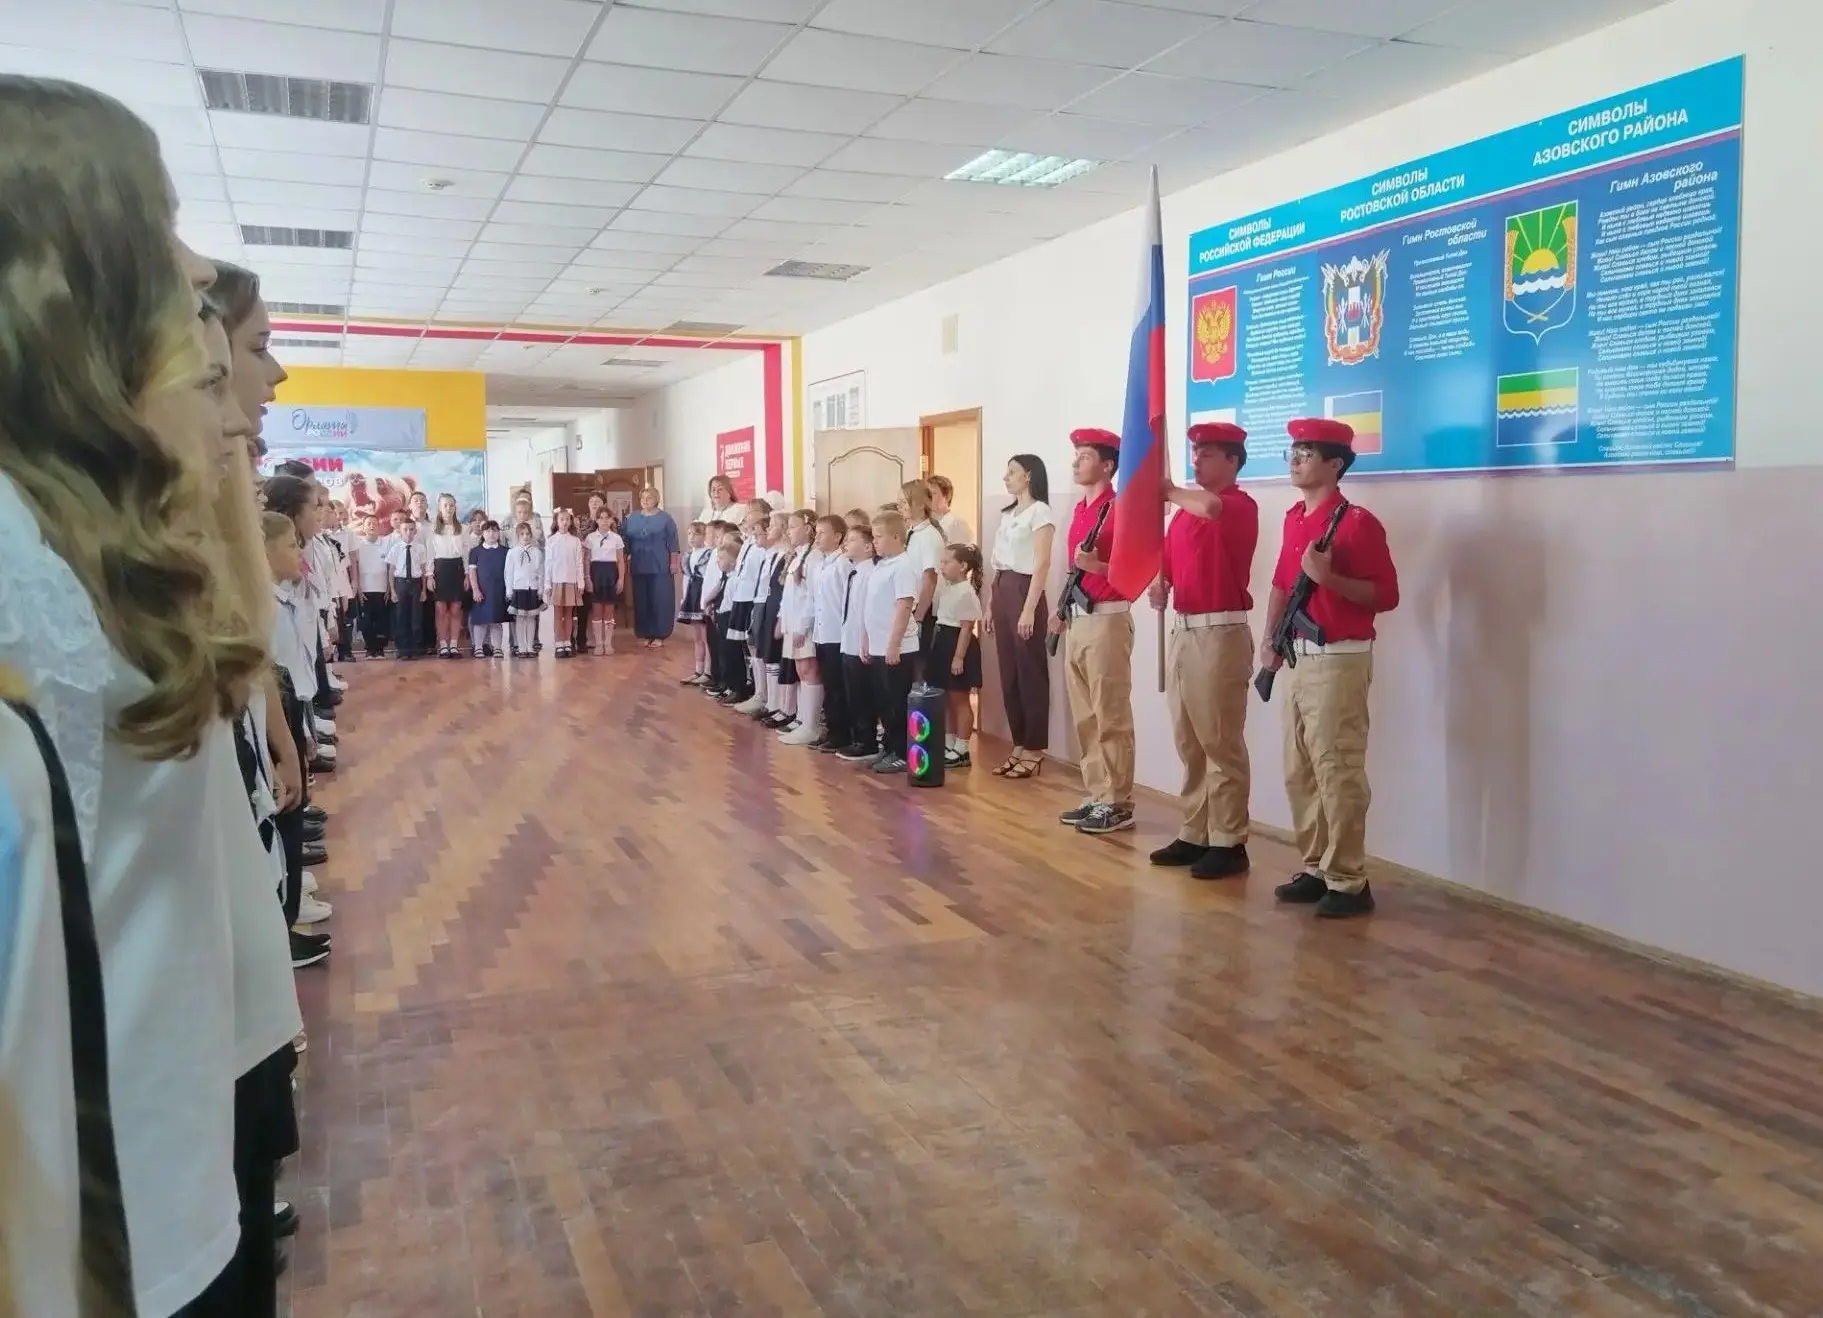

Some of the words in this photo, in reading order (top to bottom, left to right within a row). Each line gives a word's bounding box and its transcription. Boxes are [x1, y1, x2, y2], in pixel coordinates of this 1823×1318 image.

[1568, 98, 1647, 136] СИМВОЛЫ
[1533, 128, 1620, 166] АЗОВСКОГО
[1623, 108, 1688, 140] РАЙОНА
[1371, 167, 1428, 196] СИМВОЛЫ
[1610, 177, 1639, 193] Гимн
[1641, 161, 1704, 185] Азовского
[1673, 170, 1718, 192] района
[1340, 189, 1409, 223] РОСТОВСКОЙ
[1411, 174, 1465, 201] ОБЛАСТИ
[1199, 238, 1251, 263] РОССИЙСКОЙ
[1252, 222, 1305, 249] ФЕДЕРАЦИИ
[1228, 217, 1271, 240] СИМВОЛЫ
[1402, 233, 1423, 246] Гимн
[1424, 218, 1478, 241] Ростовской
[1448, 229, 1487, 246] области
